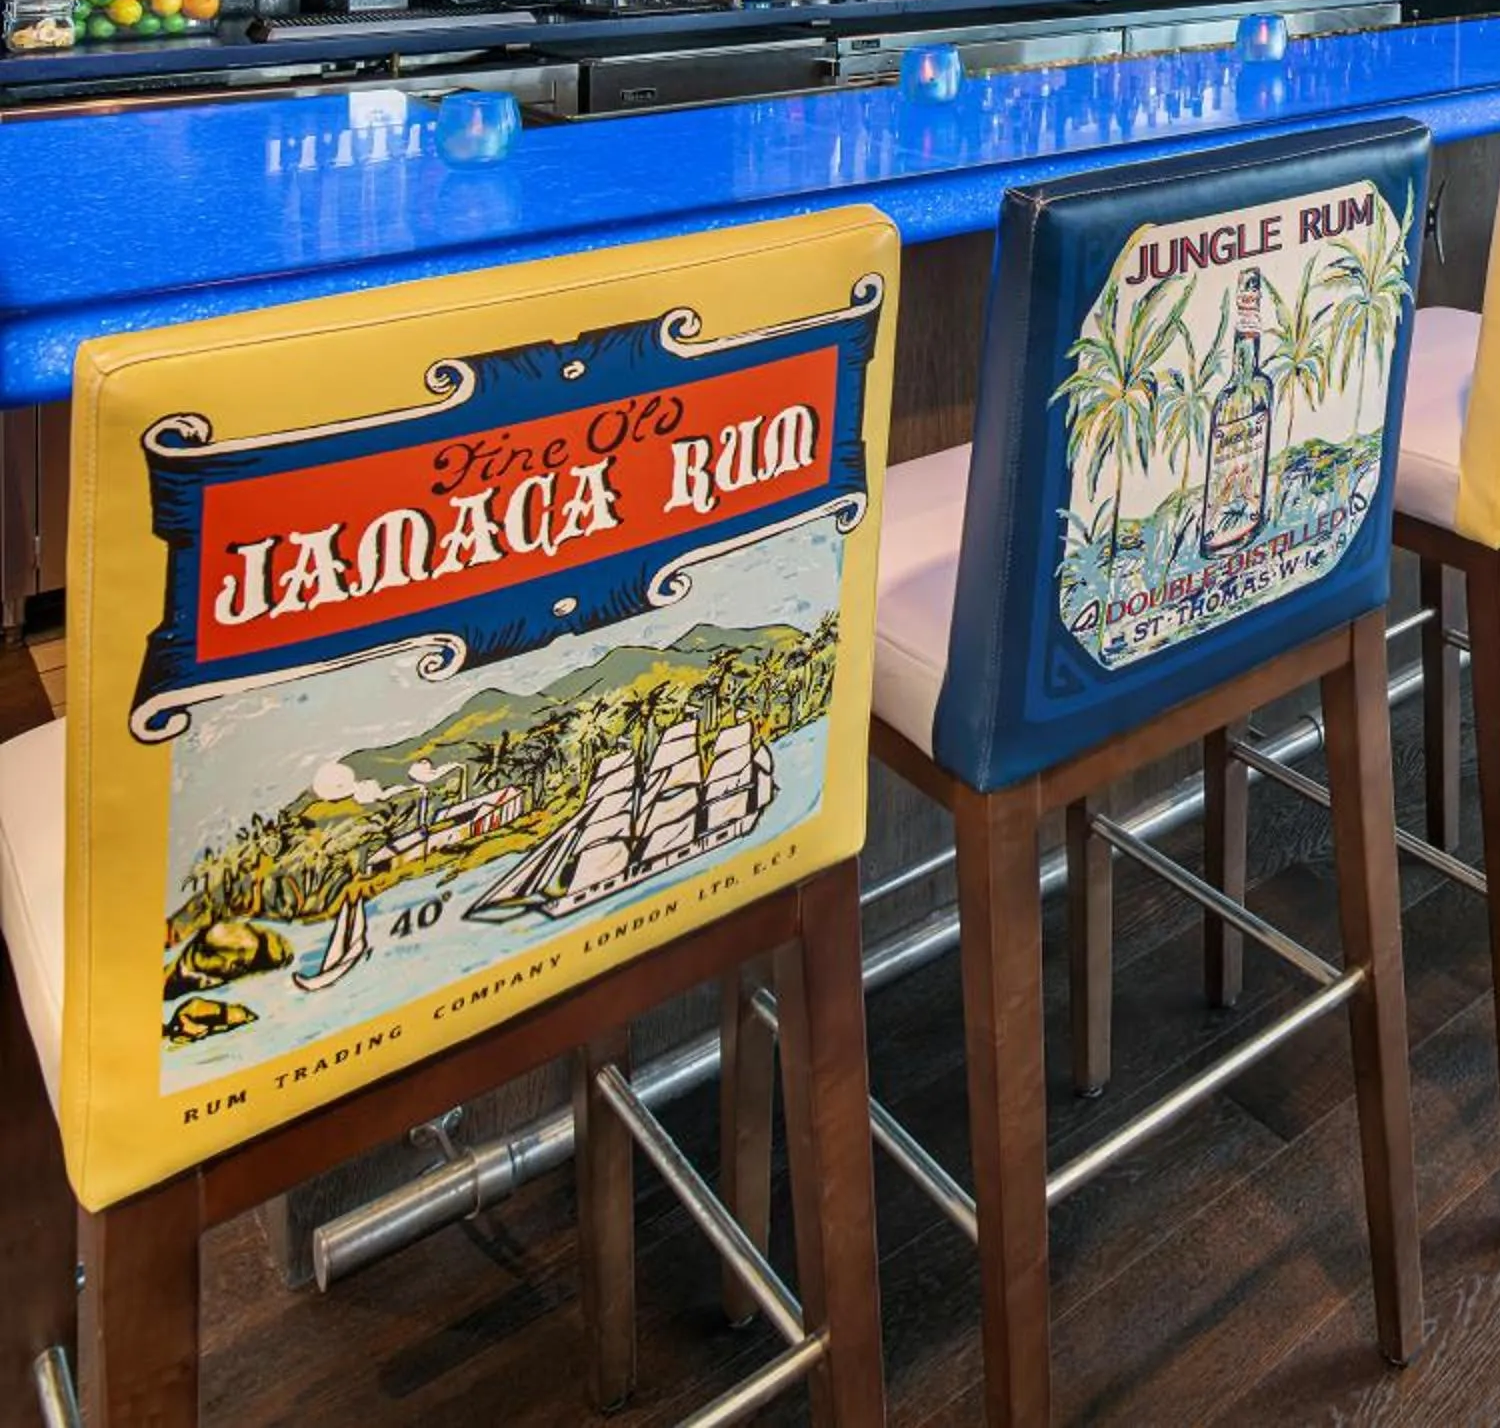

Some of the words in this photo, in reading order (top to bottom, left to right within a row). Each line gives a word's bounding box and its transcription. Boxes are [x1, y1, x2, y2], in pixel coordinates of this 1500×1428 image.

[1126, 215, 1283, 285] JUNGLE
[1299, 193, 1376, 245] RUM
[214, 456, 624, 625] JAMACA
[664, 404, 820, 515] RUM
[431, 433, 570, 495] Fine
[586, 395, 685, 455] Old
[183, 1089, 248, 1124] RUM
[274, 1024, 403, 1090] TRADING
[432, 953, 562, 1020] COMPANY
[583, 900, 679, 954] LONDON
[696, 876, 740, 902] LTD.
